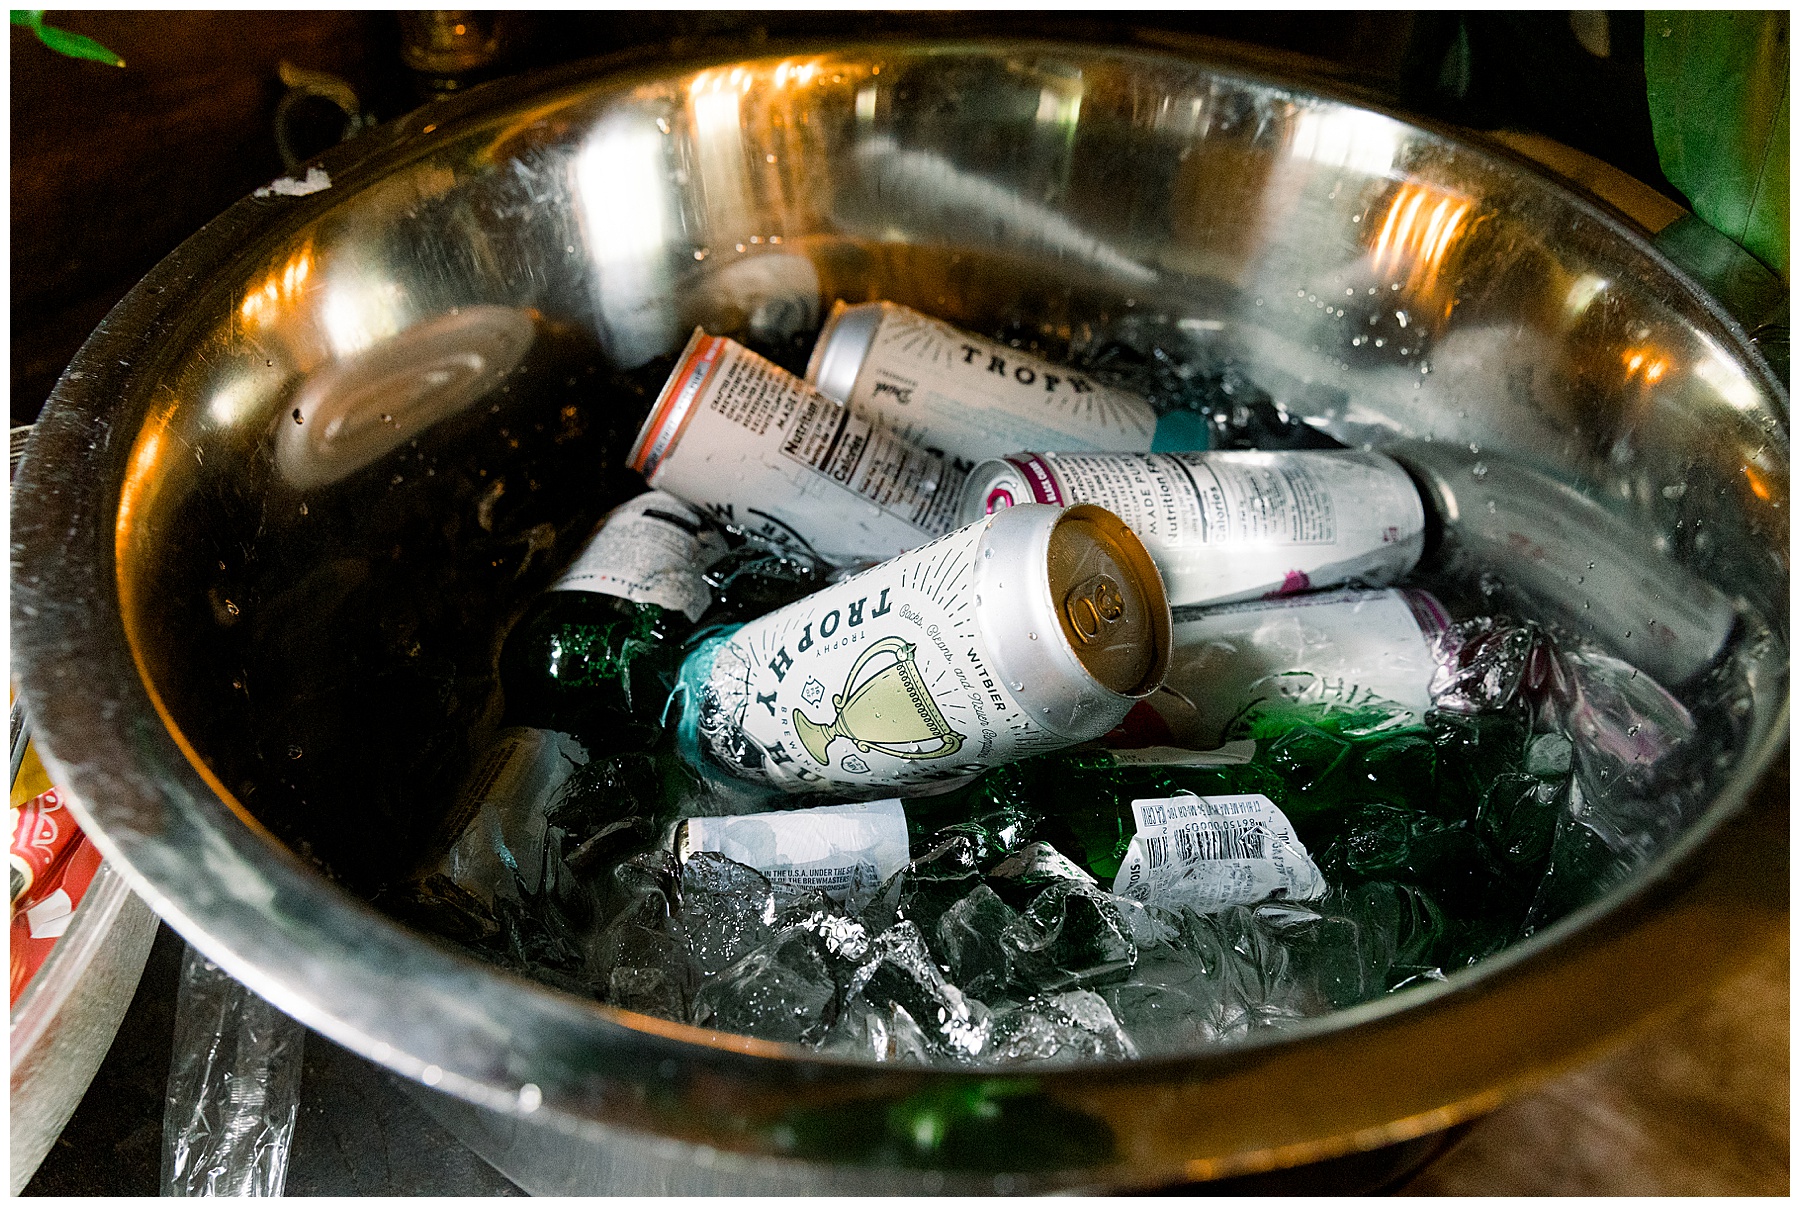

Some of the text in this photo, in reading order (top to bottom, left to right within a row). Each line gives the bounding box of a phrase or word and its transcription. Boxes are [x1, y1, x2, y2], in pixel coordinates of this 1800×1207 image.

[1140, 489, 1157, 535] MADE
[1157, 477, 1178, 543] Nutrition
[1210, 486, 1227, 542] Calories
[756, 587, 893, 718] TROPHY
[815, 631, 866, 658] TROPHY
[953, 667, 975, 690] and
[967, 692, 990, 727] Never
[967, 647, 1007, 711] WITBIER
[781, 706, 823, 773] BREWING
[1223, 818, 1255, 830] 86150
[773, 869, 787, 878] THE
[787, 869, 809, 878] U.S.A.
[809, 867, 833, 878] UNDER
